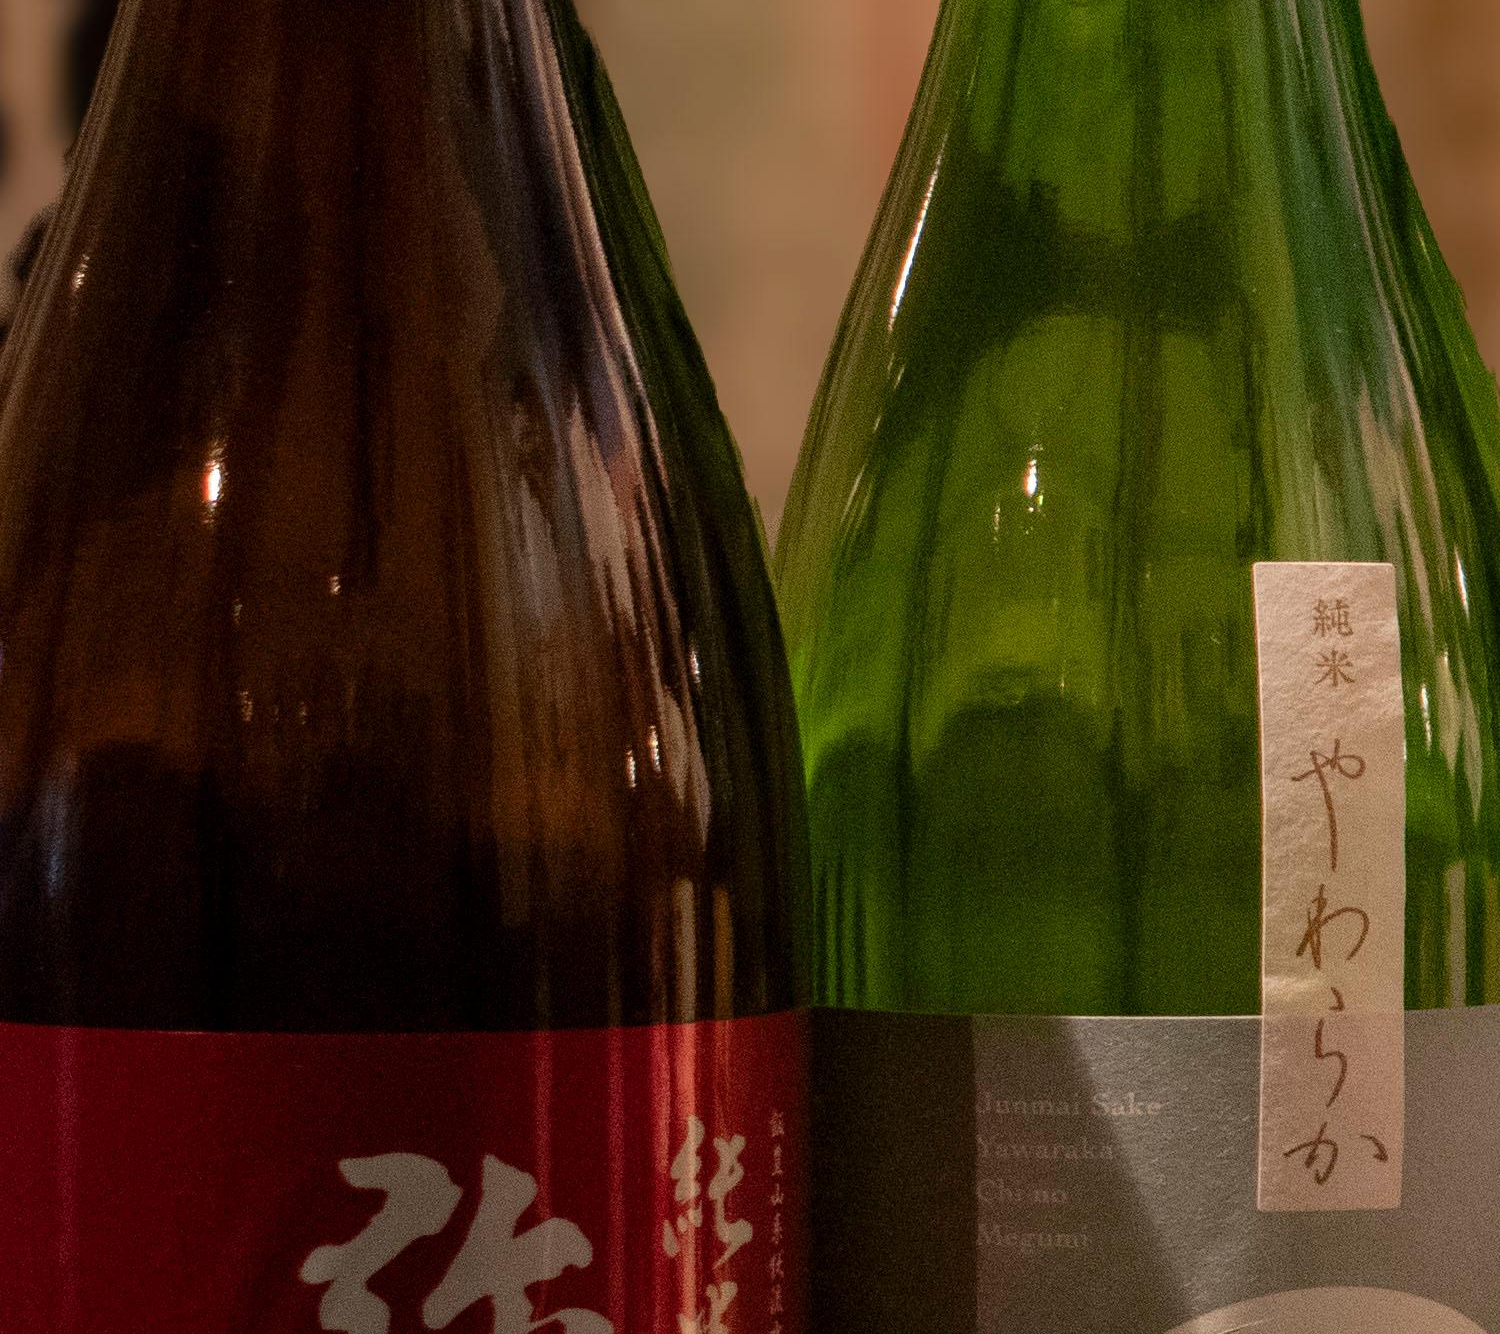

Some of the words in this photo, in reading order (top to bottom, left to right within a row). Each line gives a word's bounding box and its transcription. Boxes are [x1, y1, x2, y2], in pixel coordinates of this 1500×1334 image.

[1312, 598, 1355, 688] 純米
[1284, 738, 1388, 1186] やわらか
